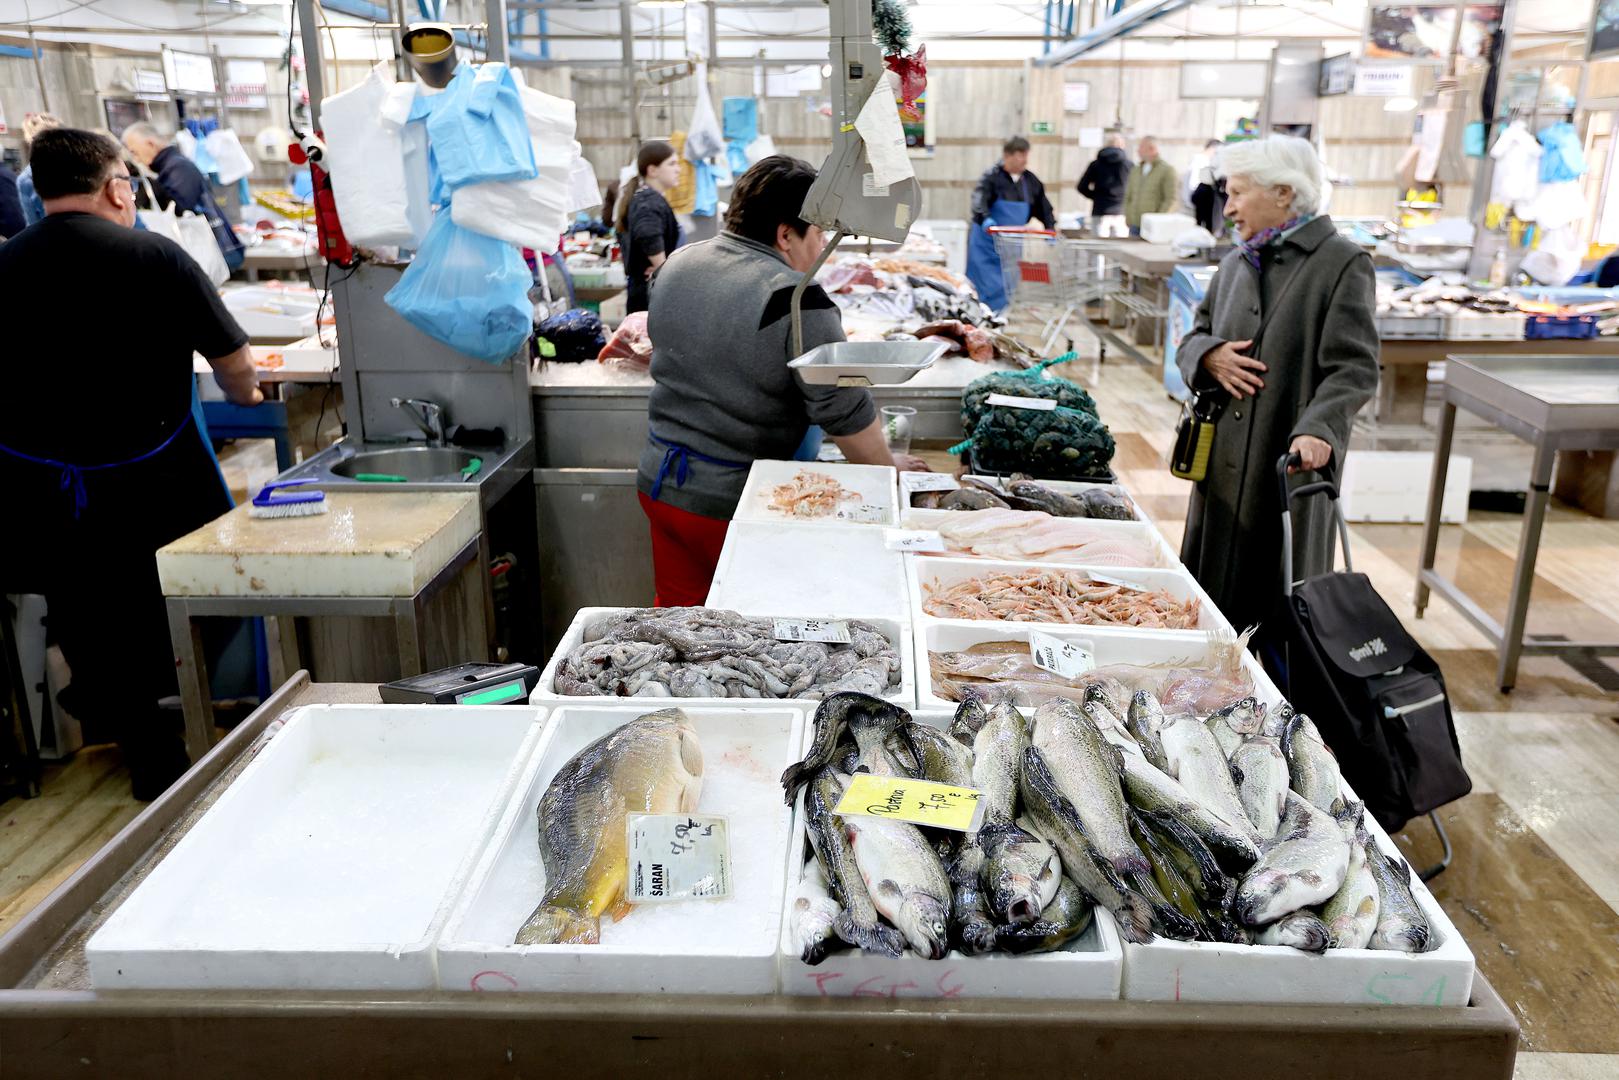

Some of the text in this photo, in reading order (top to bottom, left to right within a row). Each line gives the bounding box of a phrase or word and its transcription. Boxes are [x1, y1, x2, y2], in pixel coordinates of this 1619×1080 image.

[866, 789, 906, 815] Pastrva
[918, 793, 956, 811] 7,50
[670, 823, 696, 855] 7,50
[650, 863, 664, 897] ŠARAN
